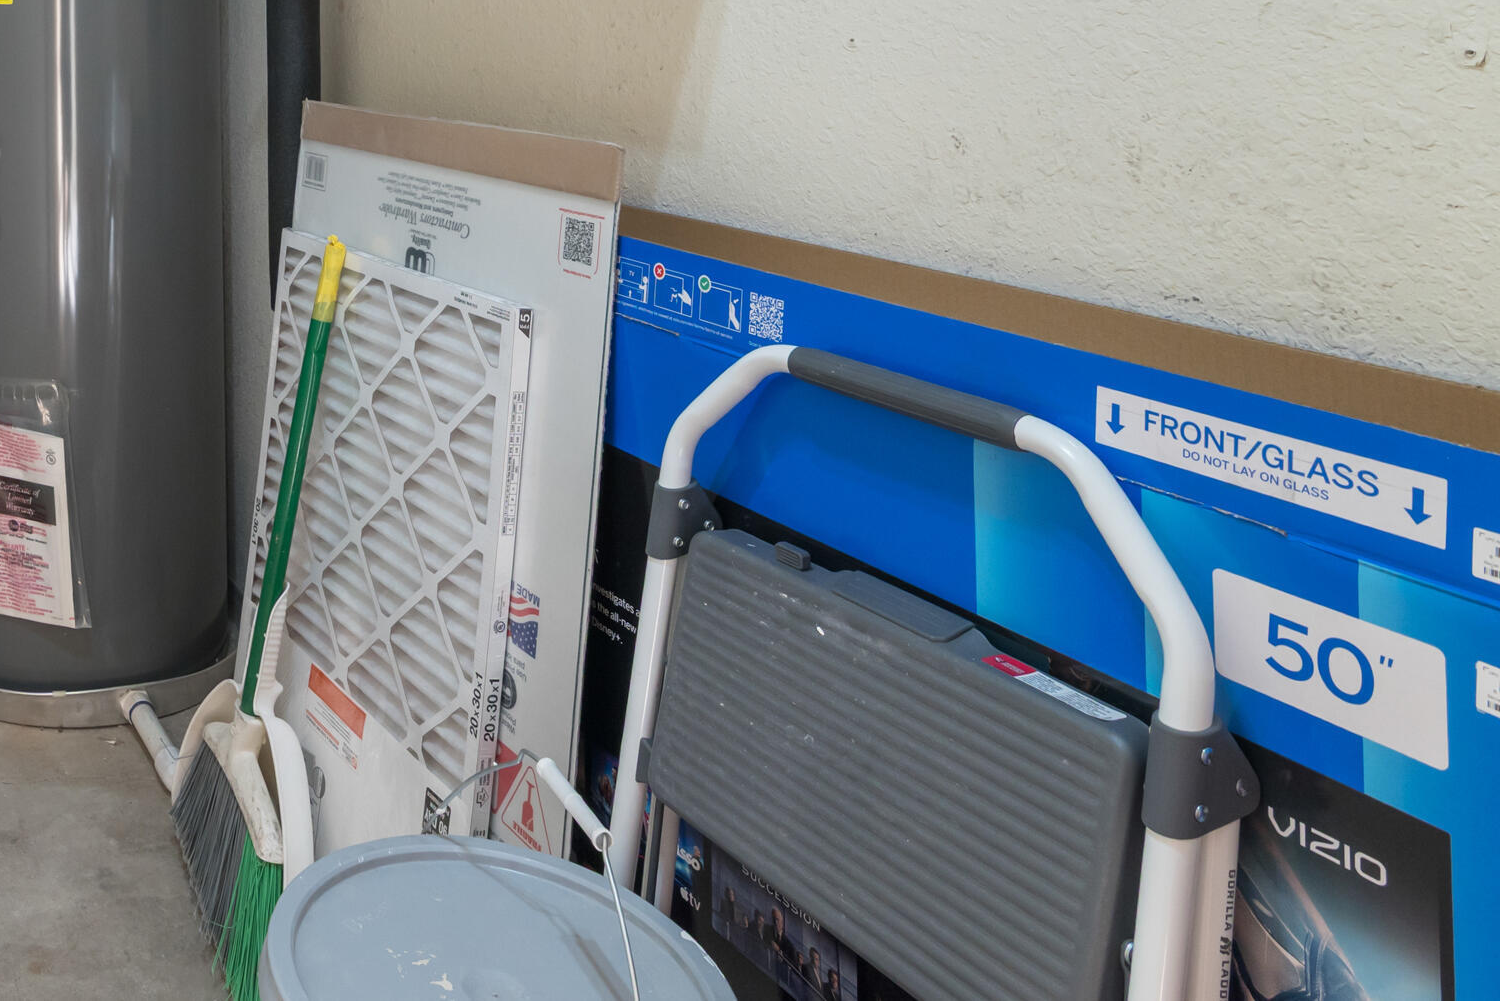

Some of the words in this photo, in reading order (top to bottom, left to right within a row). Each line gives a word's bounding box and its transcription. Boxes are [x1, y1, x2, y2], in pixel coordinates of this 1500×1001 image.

[420, 212, 470, 239] Contractors
[520, 313, 530, 323] 5
[1144, 409, 1380, 498] FRONT/GLASS
[1182, 447, 1201, 463] DO
[1203, 454, 1231, 471] NOT
[1232, 461, 1257, 479] LAY
[1260, 470, 1280, 485] ON
[1283, 476, 1329, 501] GLASS
[516, 582, 540, 608] MADE
[593, 582, 635, 614] nvestigates
[1267, 805, 1388, 887] VIZIO
[740, 863, 821, 932] SUCCESSION
[1224, 869, 1237, 932] GORILLA
[1219, 960, 1230, 1001] LADD
